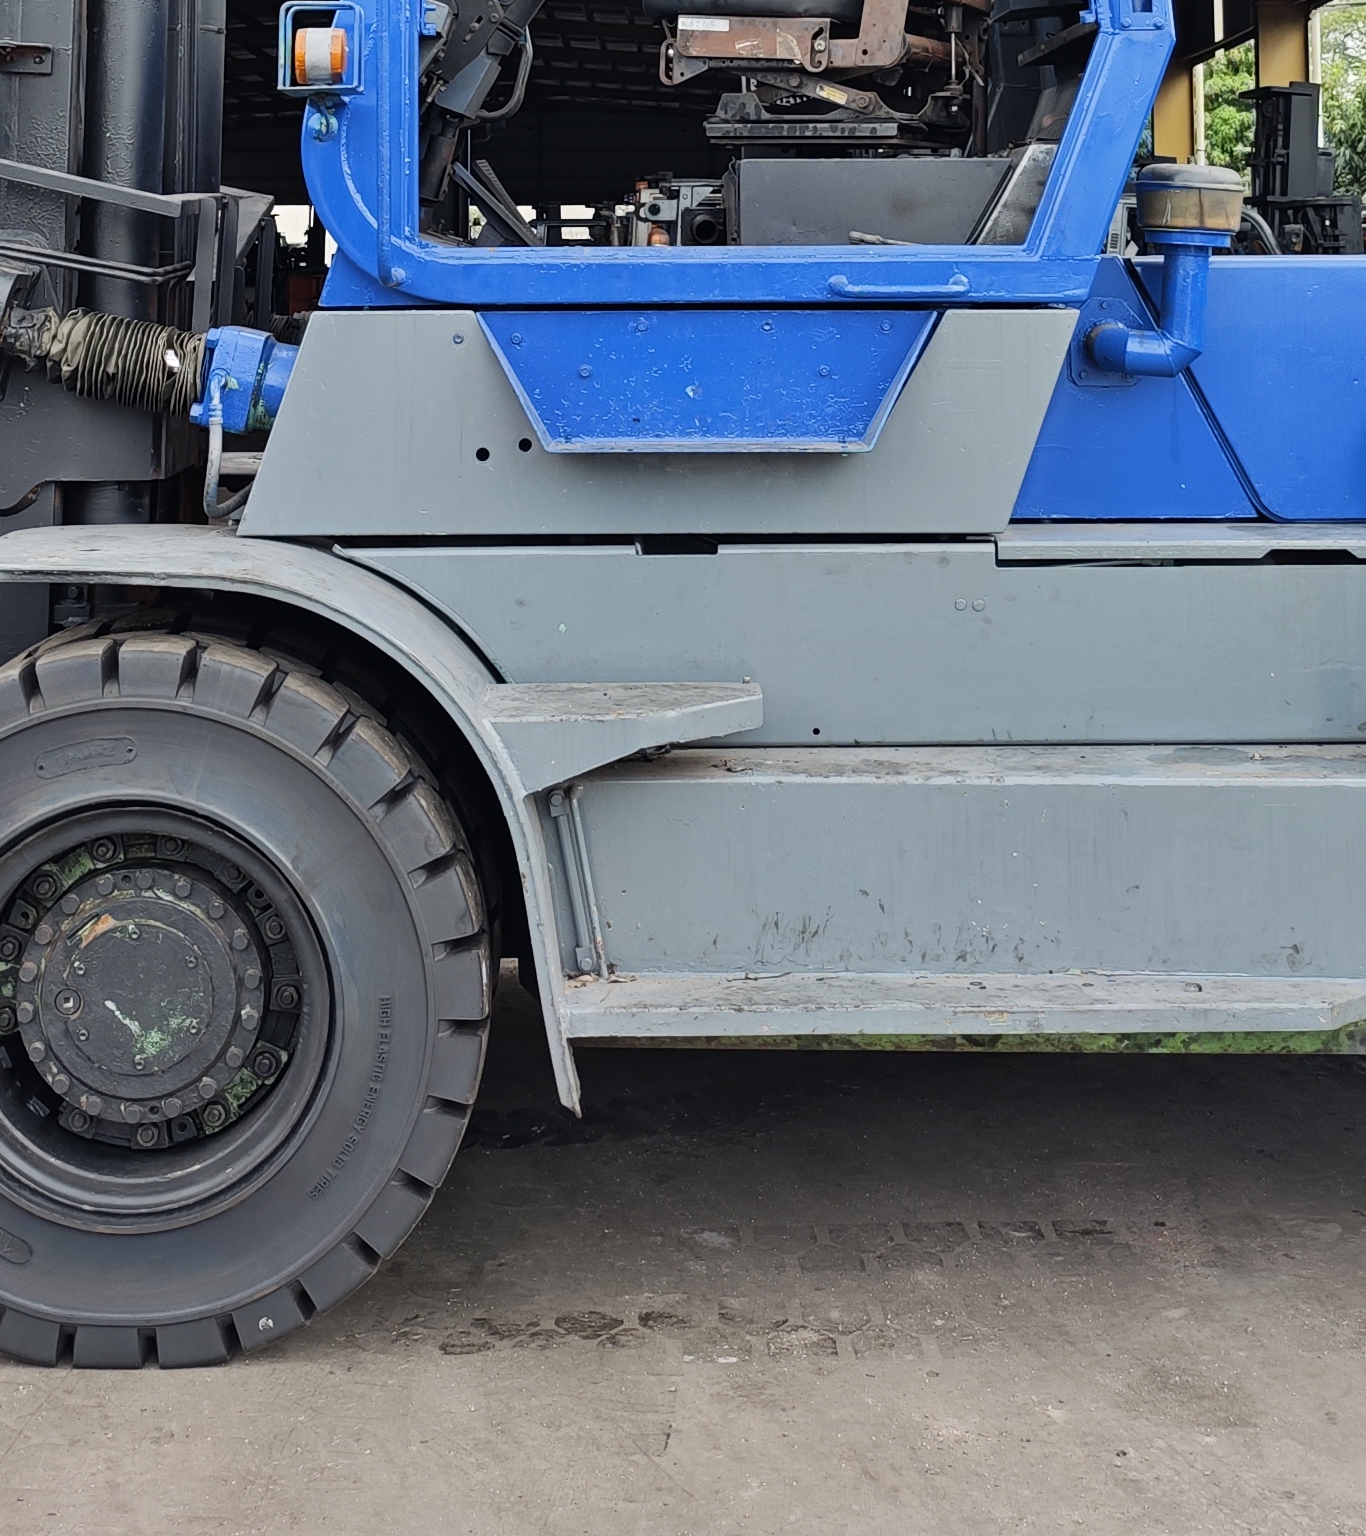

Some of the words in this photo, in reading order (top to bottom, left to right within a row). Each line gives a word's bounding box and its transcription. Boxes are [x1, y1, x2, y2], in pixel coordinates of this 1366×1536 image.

[378, 994, 392, 1028] HIGH
[370, 1030, 391, 1082] ELASTIC
[350, 1082, 380, 1135] ENERGY
[332, 1133, 359, 1170] SOLID
[308, 1168, 339, 1201] TIRES
